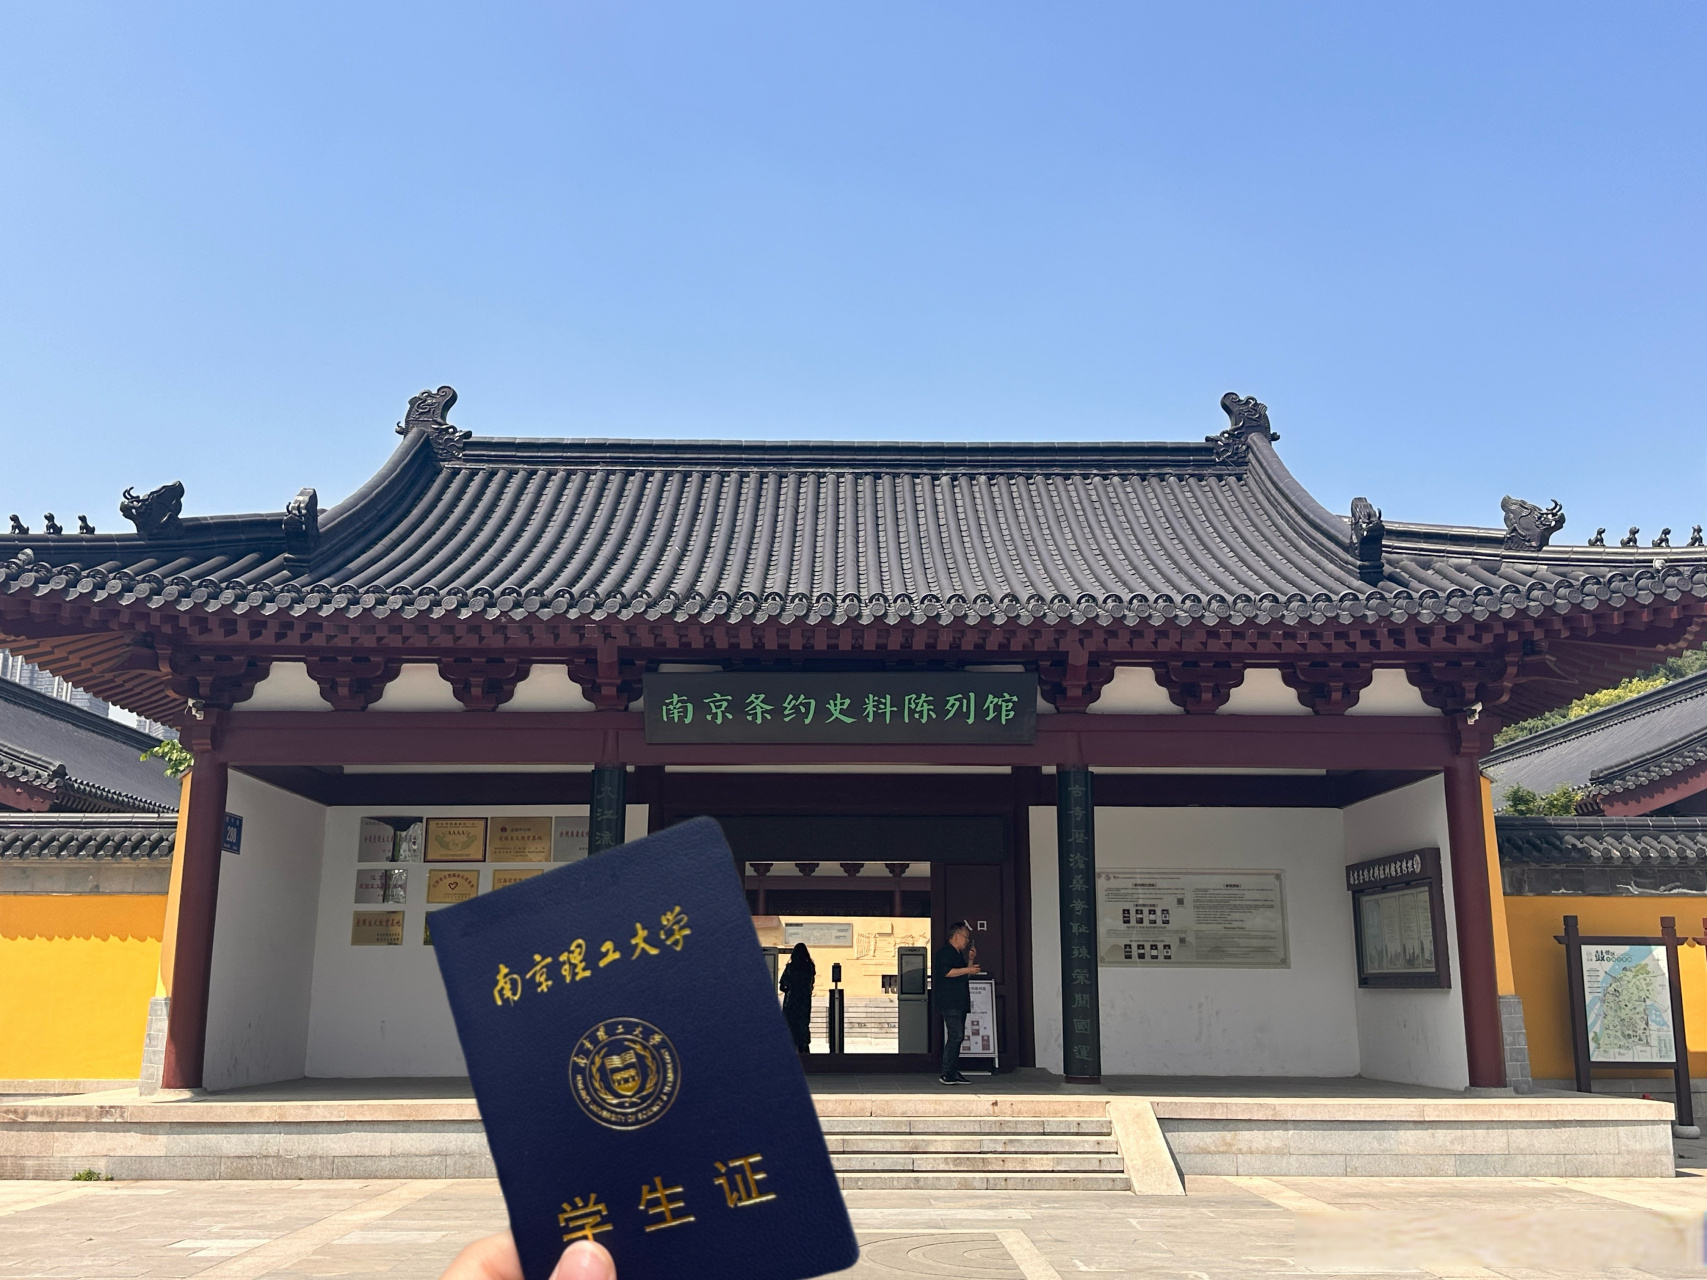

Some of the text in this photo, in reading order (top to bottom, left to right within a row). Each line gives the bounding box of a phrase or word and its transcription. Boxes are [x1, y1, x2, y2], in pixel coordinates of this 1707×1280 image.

[661, 692, 1019, 725] 南京条约史料陈列馆
[493, 905, 692, 1006] 南京理工大学
[557, 1152, 777, 1243] 学生证
